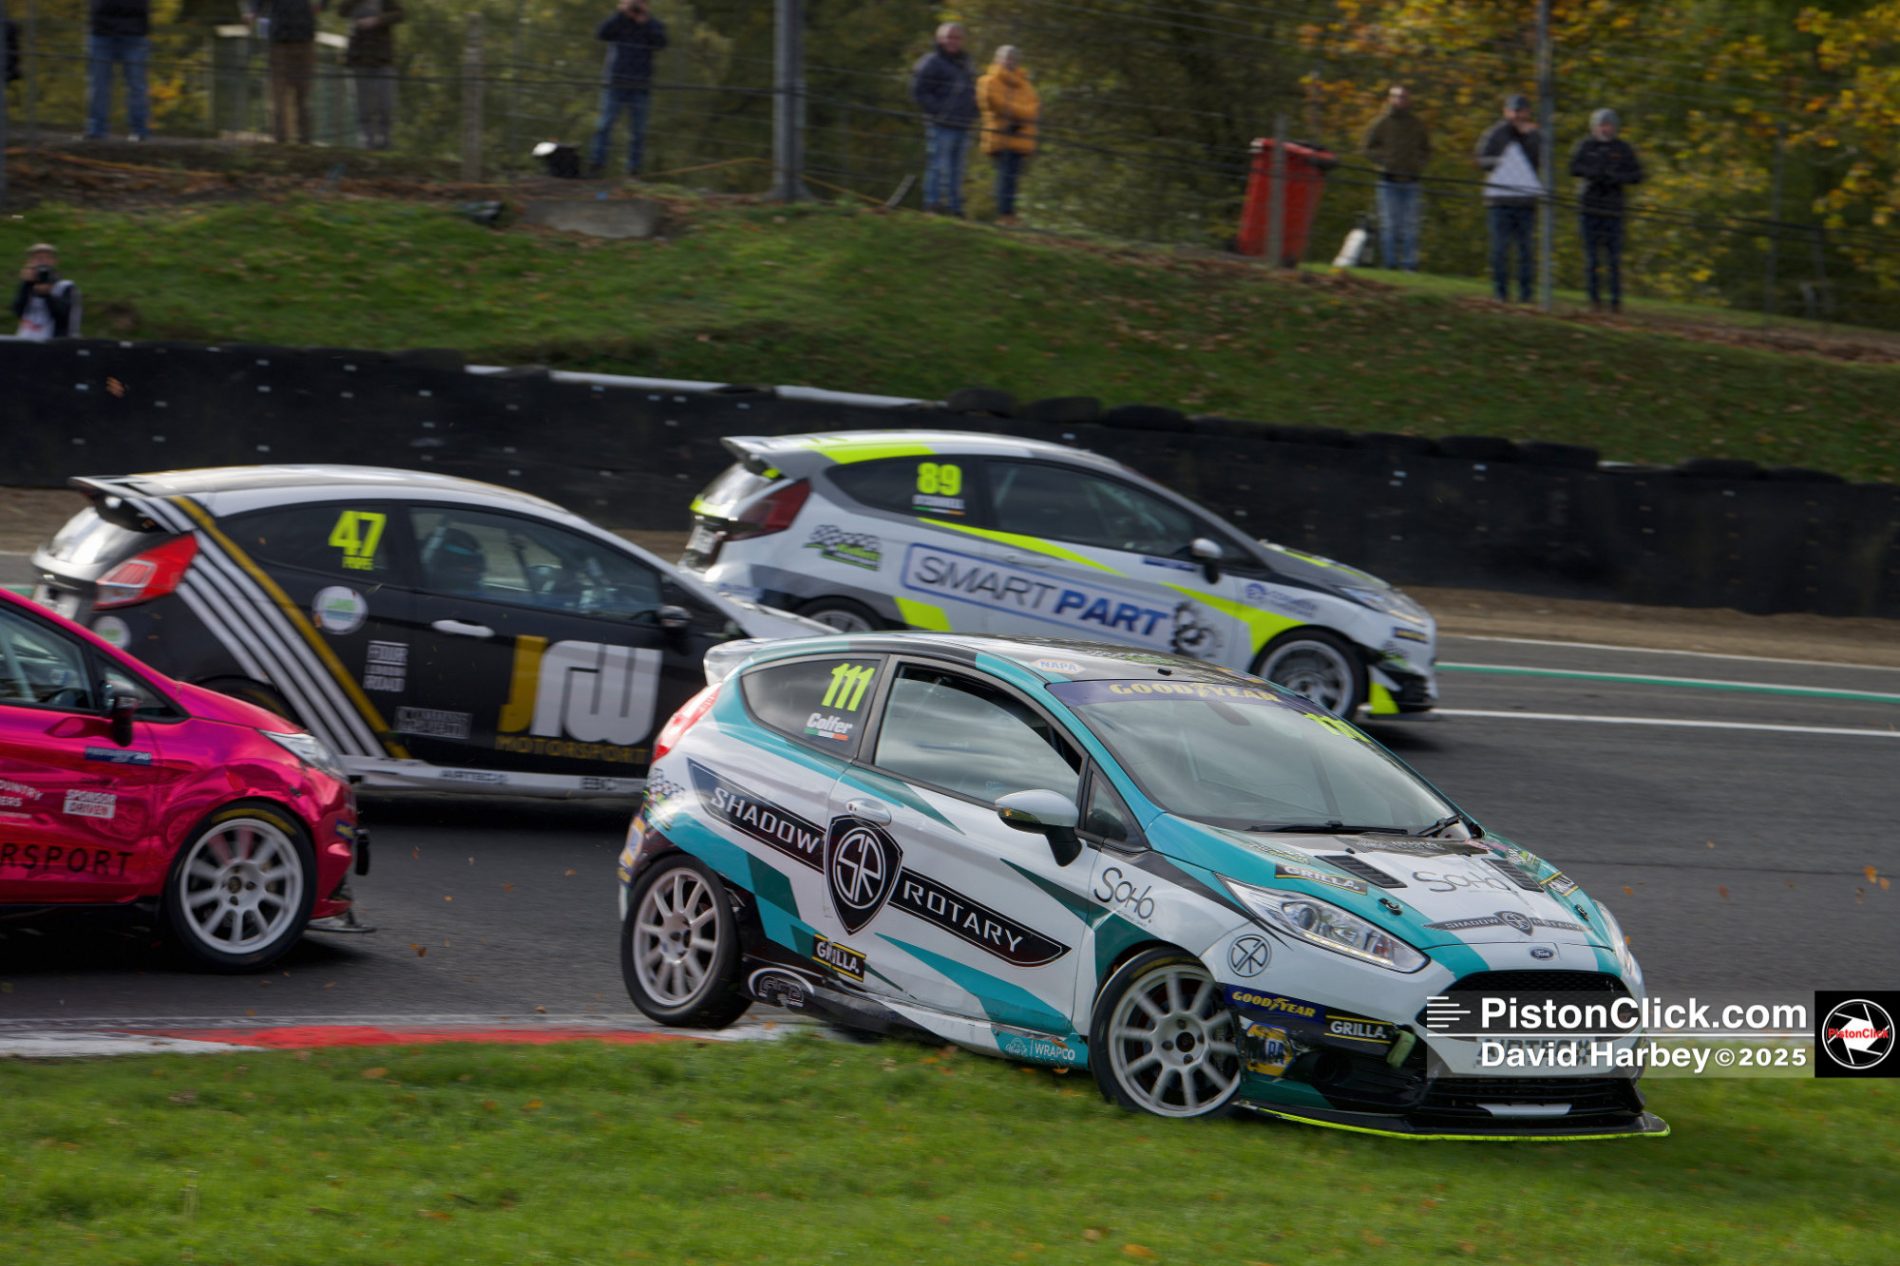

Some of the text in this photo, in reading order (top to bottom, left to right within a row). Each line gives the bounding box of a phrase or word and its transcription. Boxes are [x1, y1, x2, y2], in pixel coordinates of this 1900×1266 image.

[917, 462, 962, 496] 89
[327, 510, 387, 557] 47
[914, 556, 1168, 636] SMART PART
[1040, 658, 1079, 673] NAPA
[822, 663, 876, 712] 111
[1108, 683, 1282, 703] GOODYEAR
[806, 712, 854, 734] Colfer
[711, 787, 819, 854] SHADOW
[903, 880, 1023, 953] ROTARY
[1232, 991, 1316, 1018] GOODYEAR
[1035, 1043, 1076, 1061] WRAPCO
